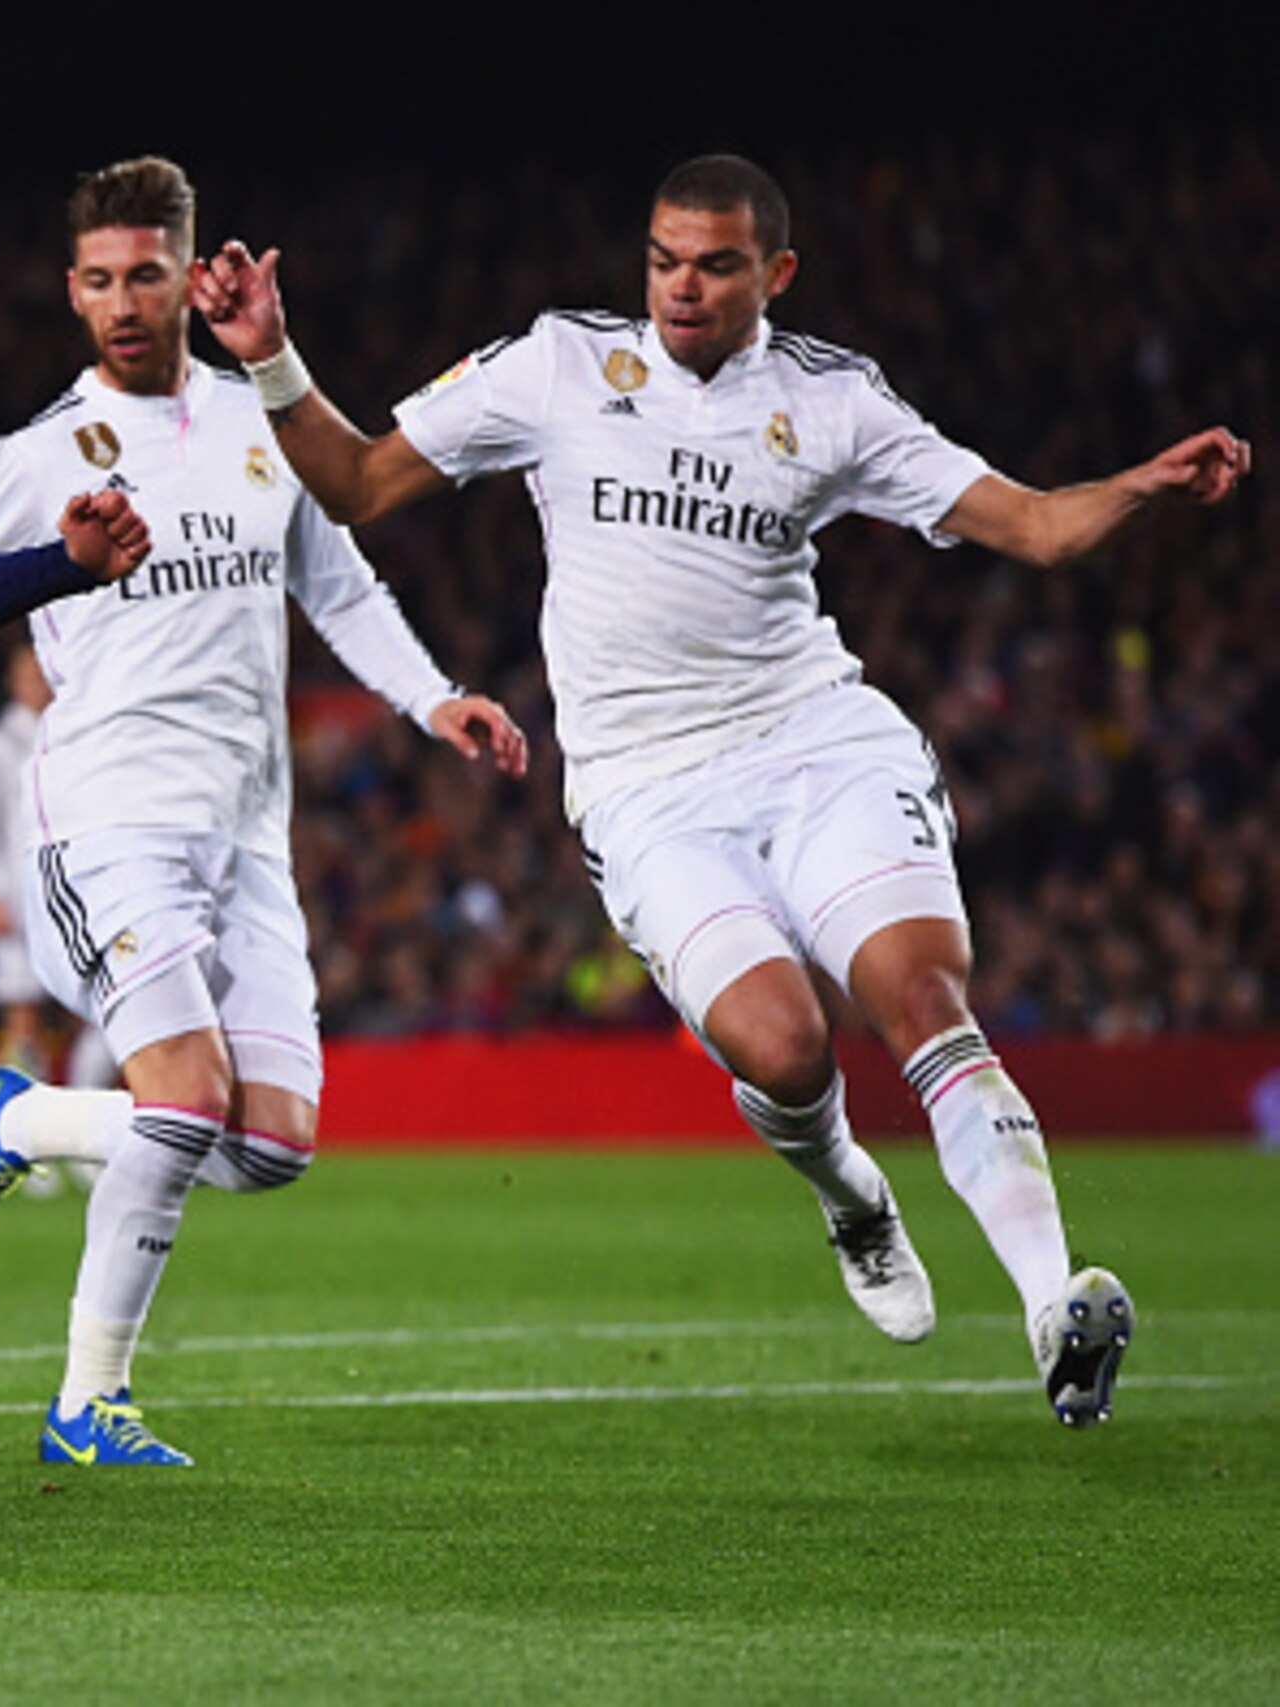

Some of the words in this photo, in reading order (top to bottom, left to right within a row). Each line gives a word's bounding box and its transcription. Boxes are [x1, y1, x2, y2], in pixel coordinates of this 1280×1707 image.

[670, 447, 733, 492] Fly
[179, 512, 234, 544] Fly
[593, 477, 799, 555] Emirates
[895, 790, 937, 849] 3
